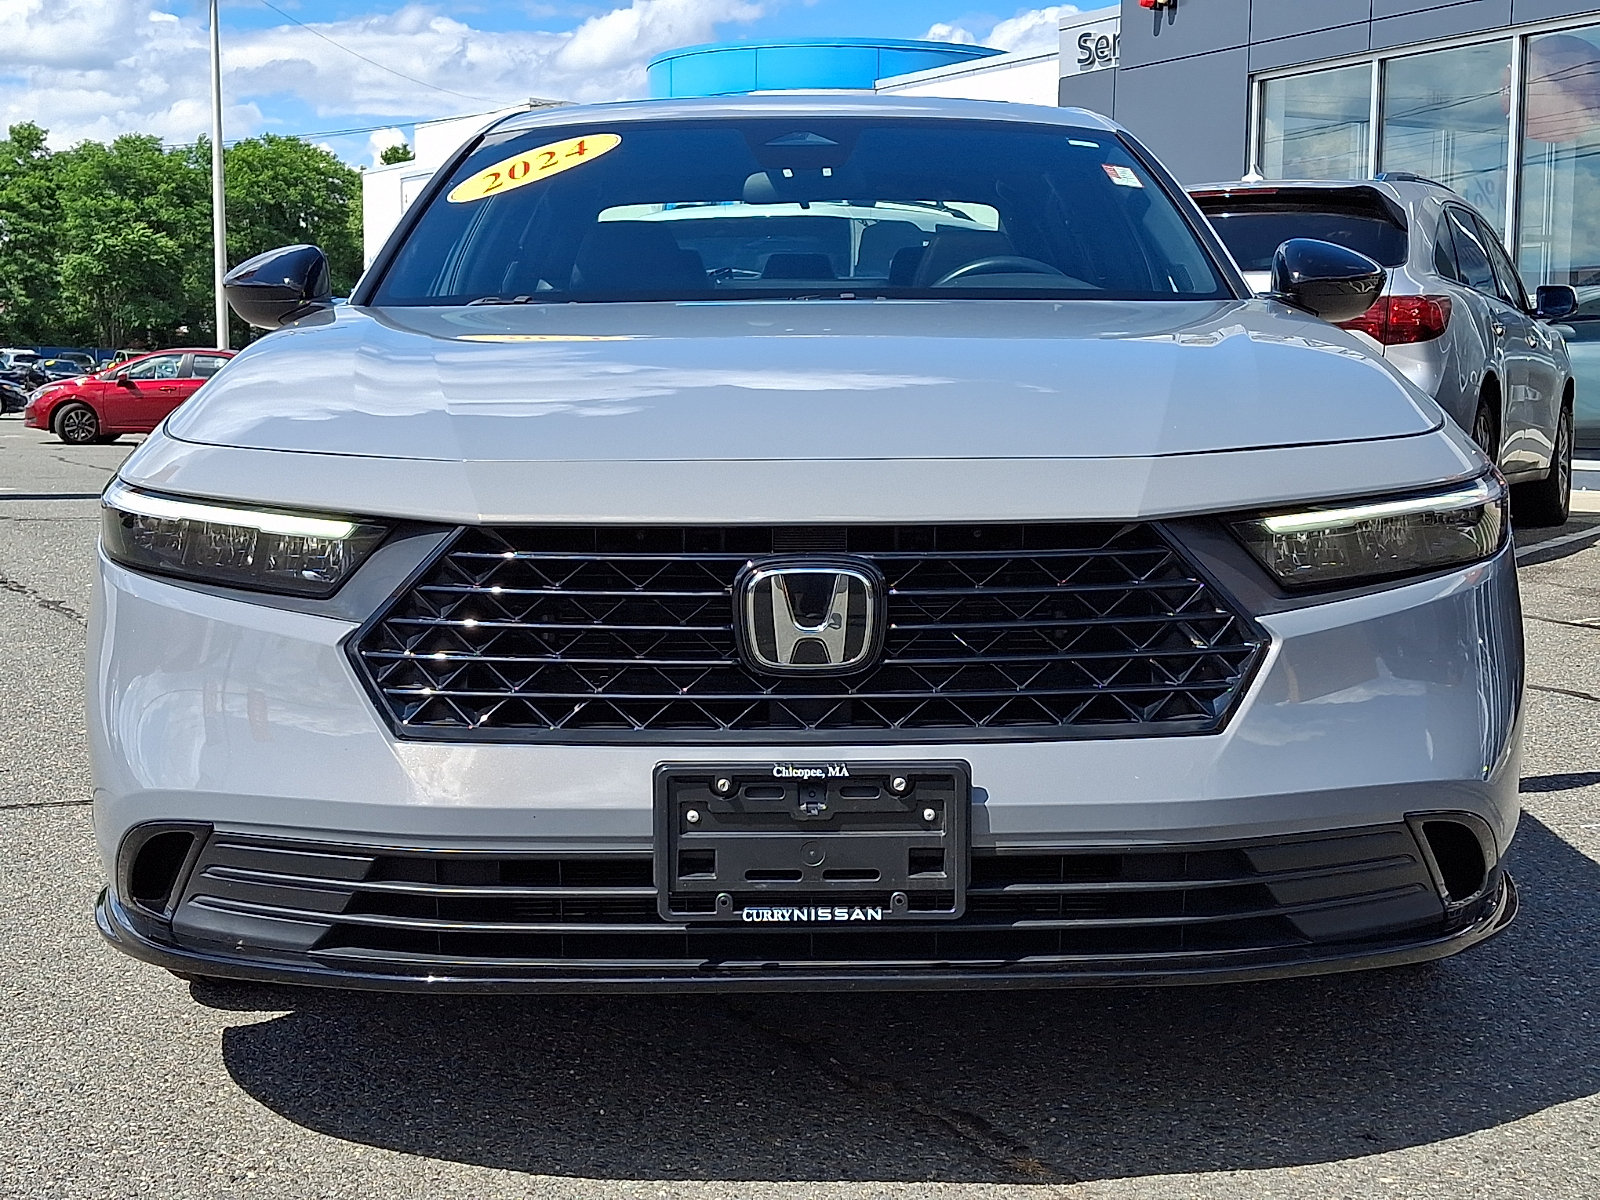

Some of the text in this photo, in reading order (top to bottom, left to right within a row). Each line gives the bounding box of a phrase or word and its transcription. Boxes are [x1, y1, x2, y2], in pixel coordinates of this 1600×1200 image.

[483, 140, 588, 193] 2024
[773, 765, 850, 780] Chicopee, MA
